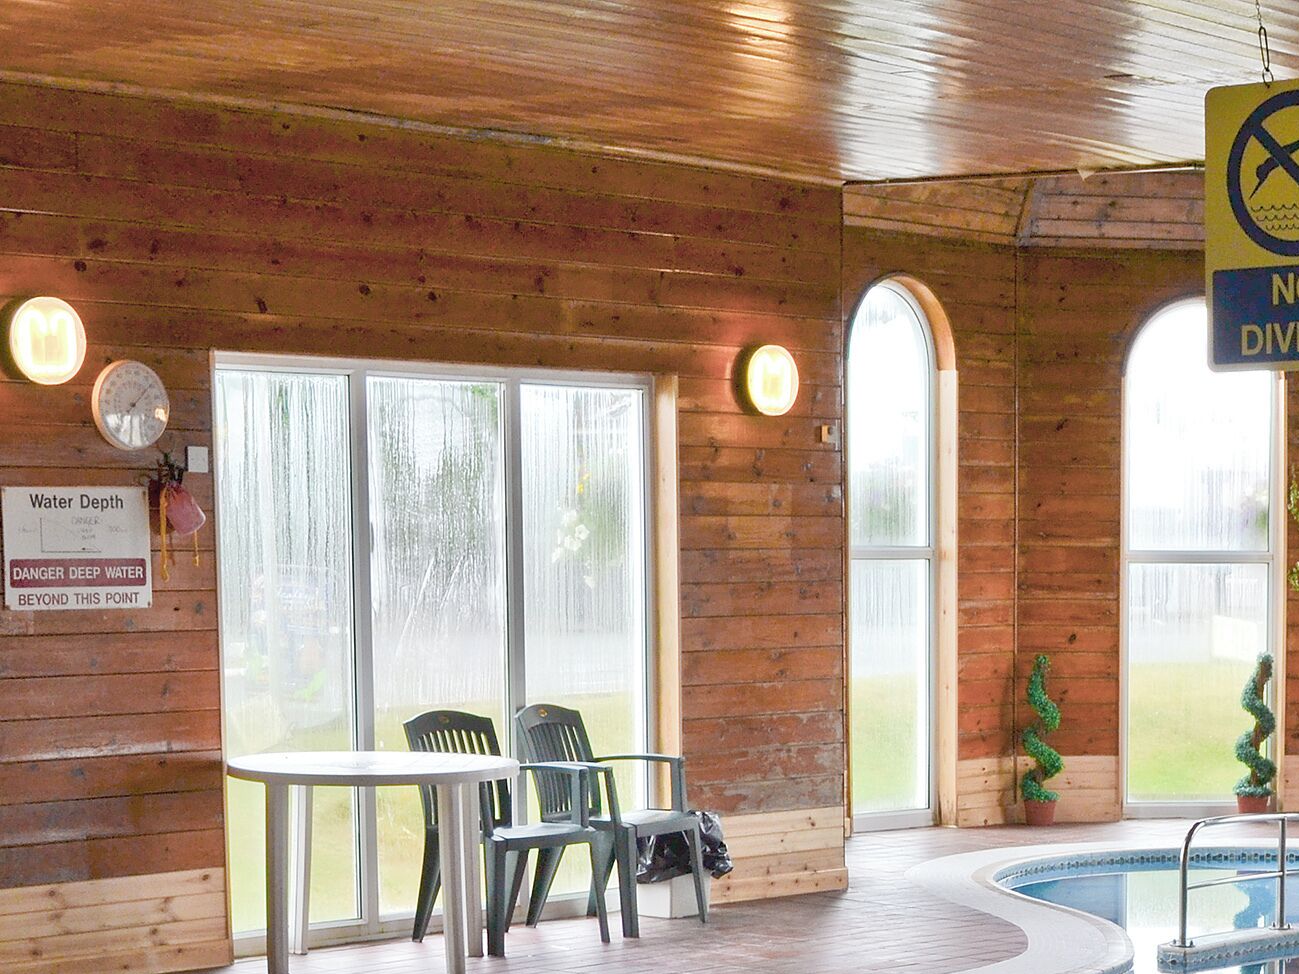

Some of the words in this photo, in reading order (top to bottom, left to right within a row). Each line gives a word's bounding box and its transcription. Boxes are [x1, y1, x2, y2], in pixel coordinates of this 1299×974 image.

[30, 494, 73, 509] Water
[80, 494, 124, 512] Depth
[13, 567, 65, 580] DANGER
[69, 566, 100, 579] DEEP
[105, 566, 143, 579] WATER
[18, 593, 69, 606] BEYOND
[74, 593, 100, 605] THIS
[105, 592, 139, 604] POINT
